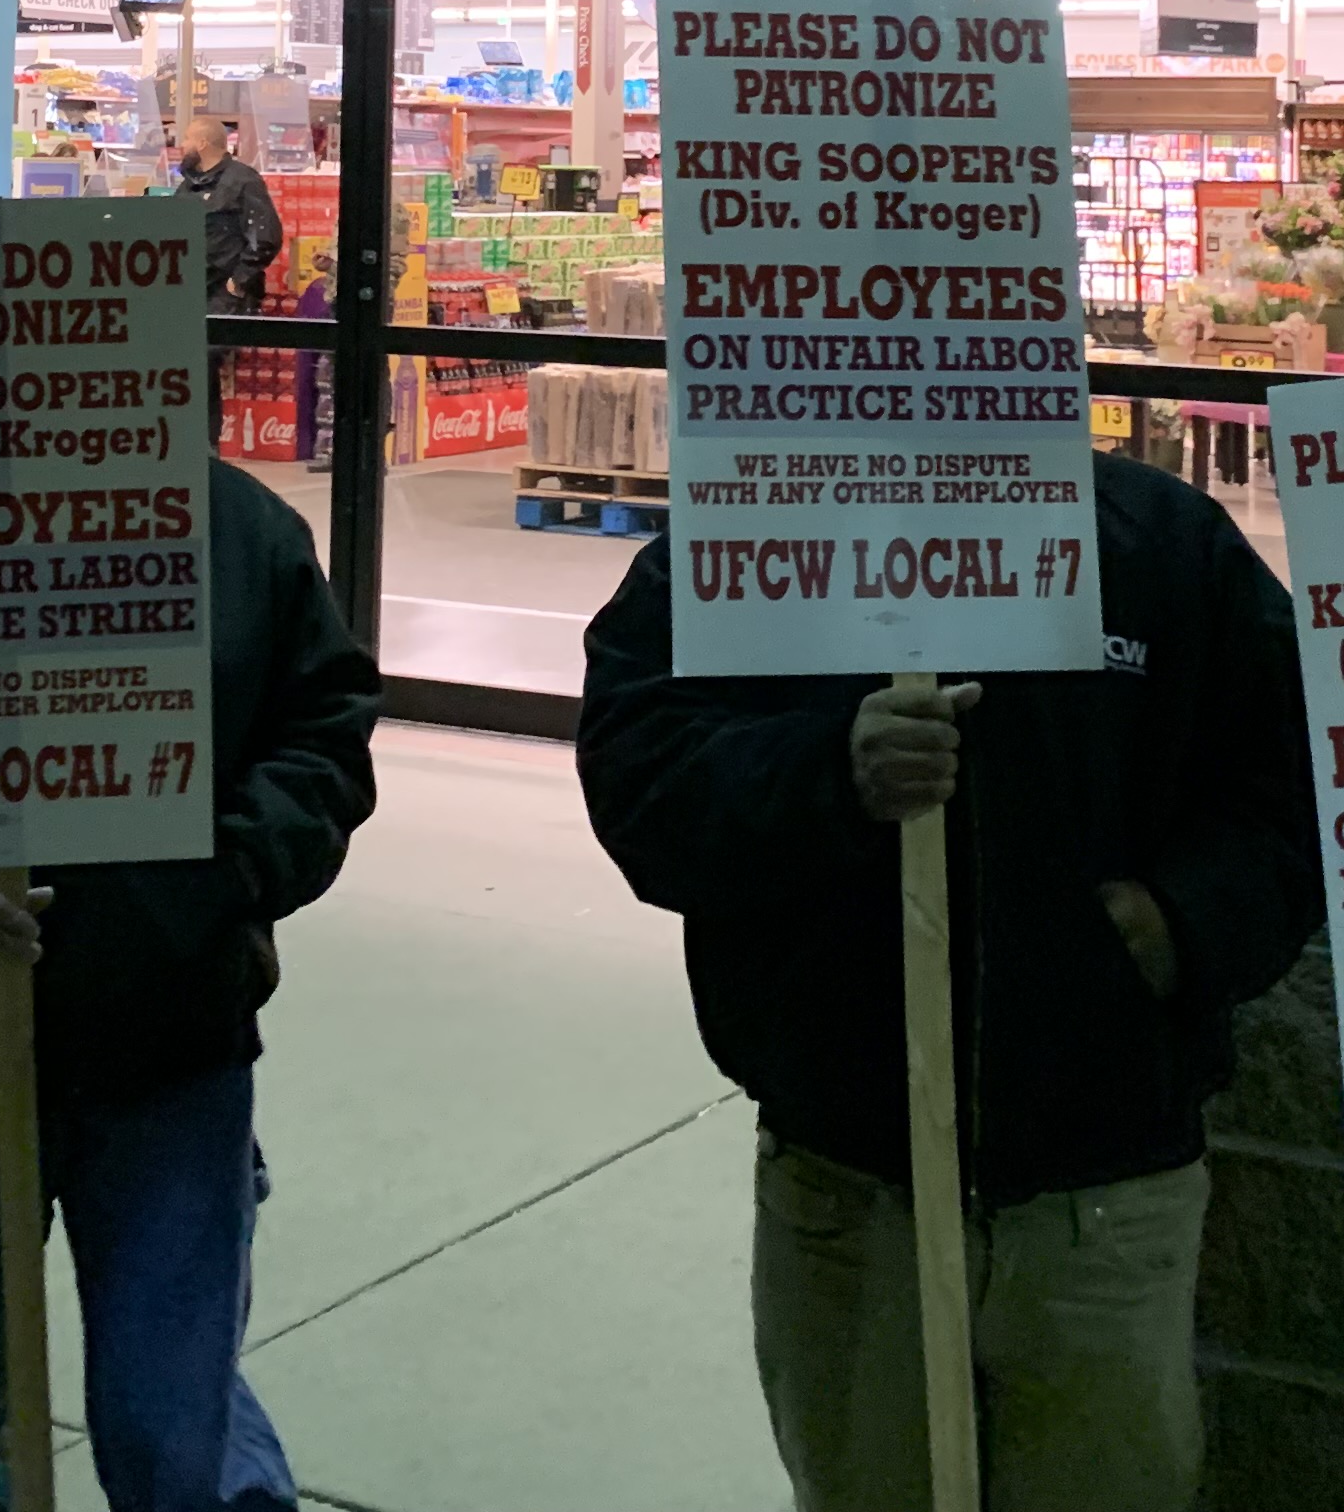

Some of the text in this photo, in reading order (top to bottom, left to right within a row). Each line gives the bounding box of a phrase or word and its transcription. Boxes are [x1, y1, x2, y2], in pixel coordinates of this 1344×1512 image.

[673, 11, 1050, 64] PLEASE DO NOT
[1209, 54, 1263, 74] PARK
[734, 69, 997, 119] PATRONIZE
[675, 141, 1059, 185] KING SOOPER'S
[700, 189, 1040, 240] (Div. of Kroger)
[3, 241, 72, 289] DO
[89, 239, 189, 288] NOT
[682, 263, 1067, 322] EMPLOYEES
[683, 334, 1081, 372] ON UNFAIR LABOR
[686, 384, 1080, 422] PRACTICE STRIKE
[733, 454, 1031, 477] WE HAVE NO DISPUTE
[688, 480, 1079, 505] WITH ANY OTHER EMPLOYER
[48, 552, 199, 591] LABOR
[690, 537, 1081, 602] UFCW LOCAL #7
[38, 598, 195, 639] STRIKE
[31, 666, 148, 689] DISPUTE
[48, 689, 194, 715] EMPLOYER
[147, 741, 195, 796] #7
